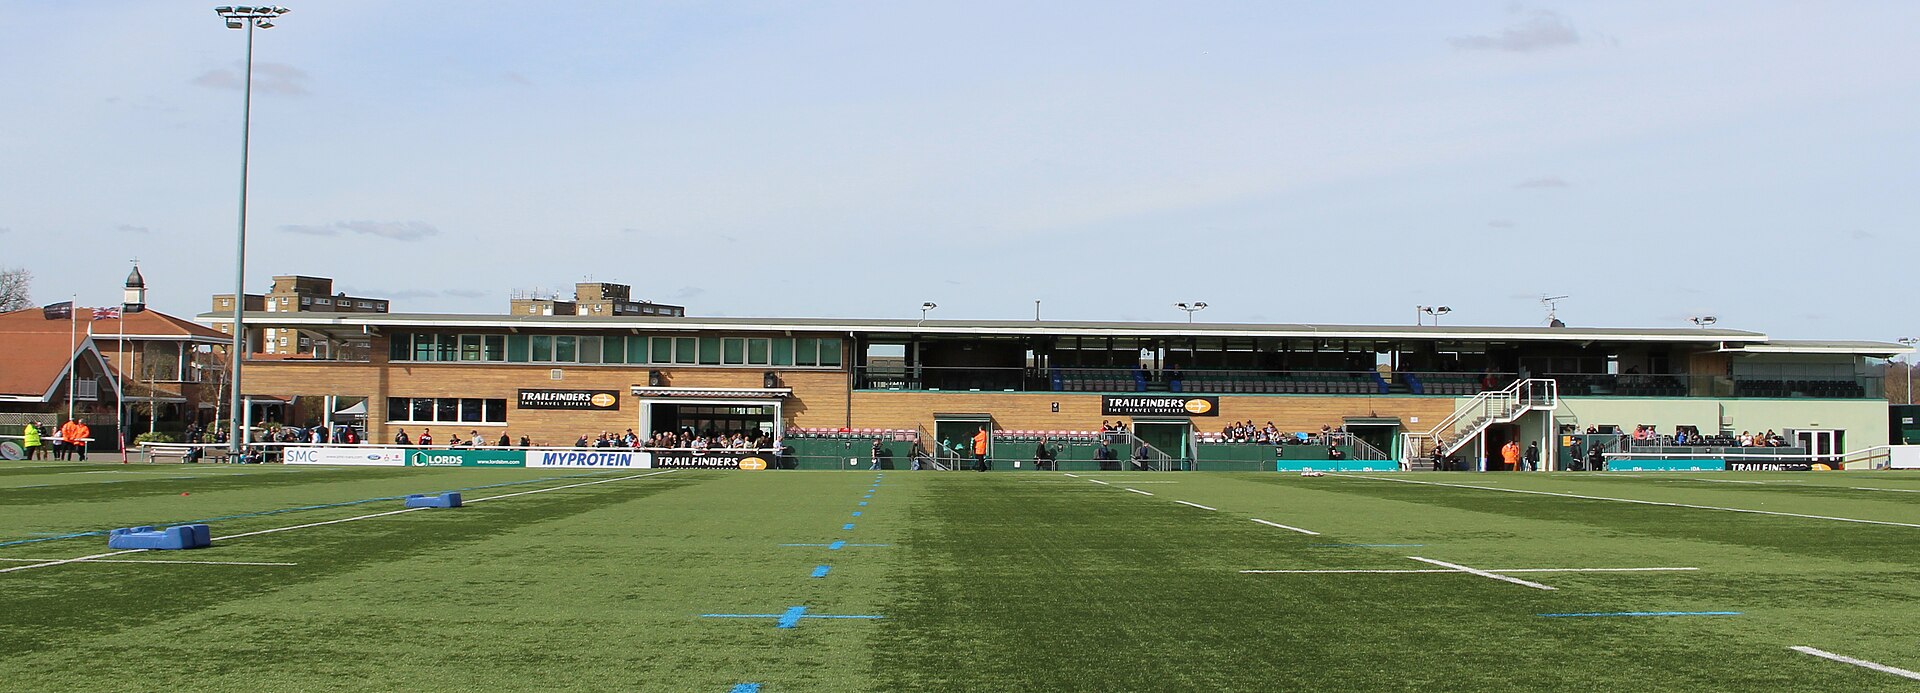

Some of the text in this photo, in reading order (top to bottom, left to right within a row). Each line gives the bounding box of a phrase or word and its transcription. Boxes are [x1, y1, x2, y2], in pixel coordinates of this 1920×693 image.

[521, 392, 591, 401] TRAILFINDERS
[1108, 398, 1185, 408] TRAILFINDERS
[287, 450, 318, 462] SMC
[428, 455, 463, 464] LORDS
[542, 452, 632, 466] MYPROTEIN
[657, 456, 739, 466] TRAILFINDERS
